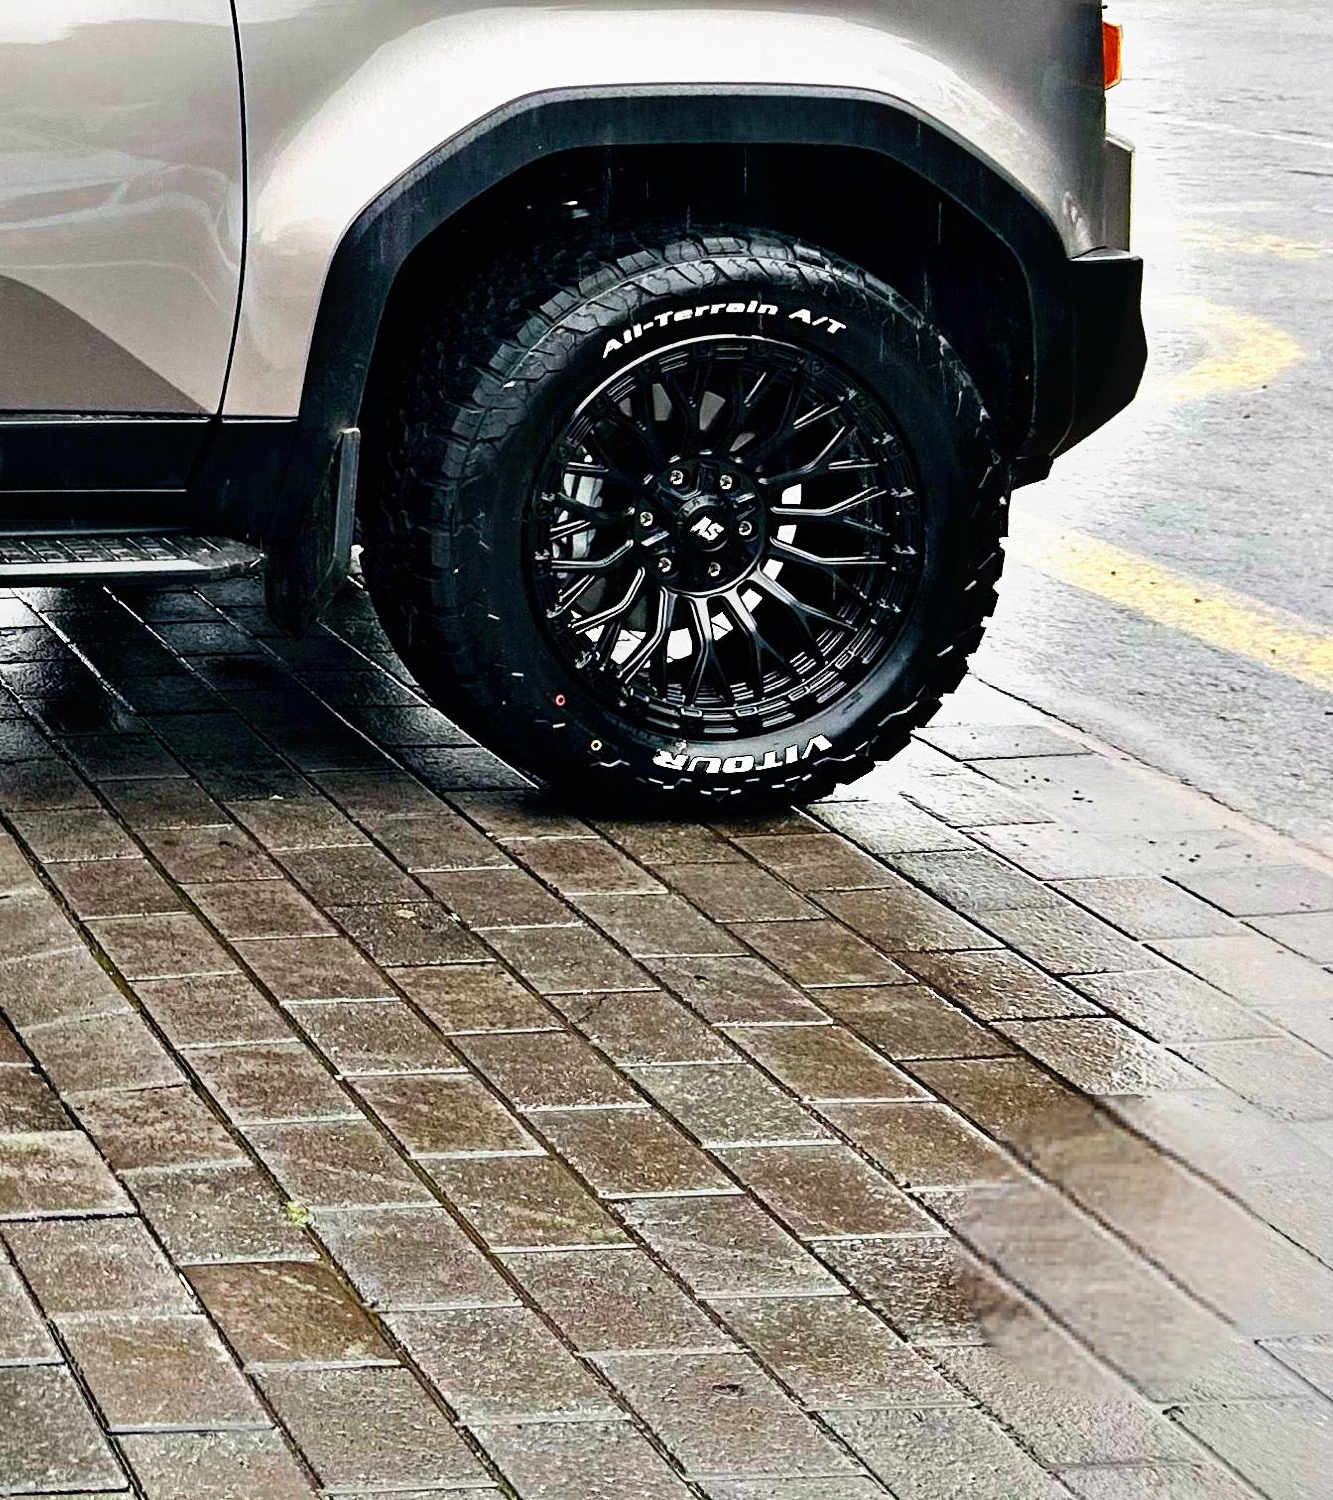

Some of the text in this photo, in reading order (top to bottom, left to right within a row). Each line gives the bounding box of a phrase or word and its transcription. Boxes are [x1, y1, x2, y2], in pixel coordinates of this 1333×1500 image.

[602, 300, 847, 359] All-Terrain A/T
[652, 733, 833, 774] VITOUR
